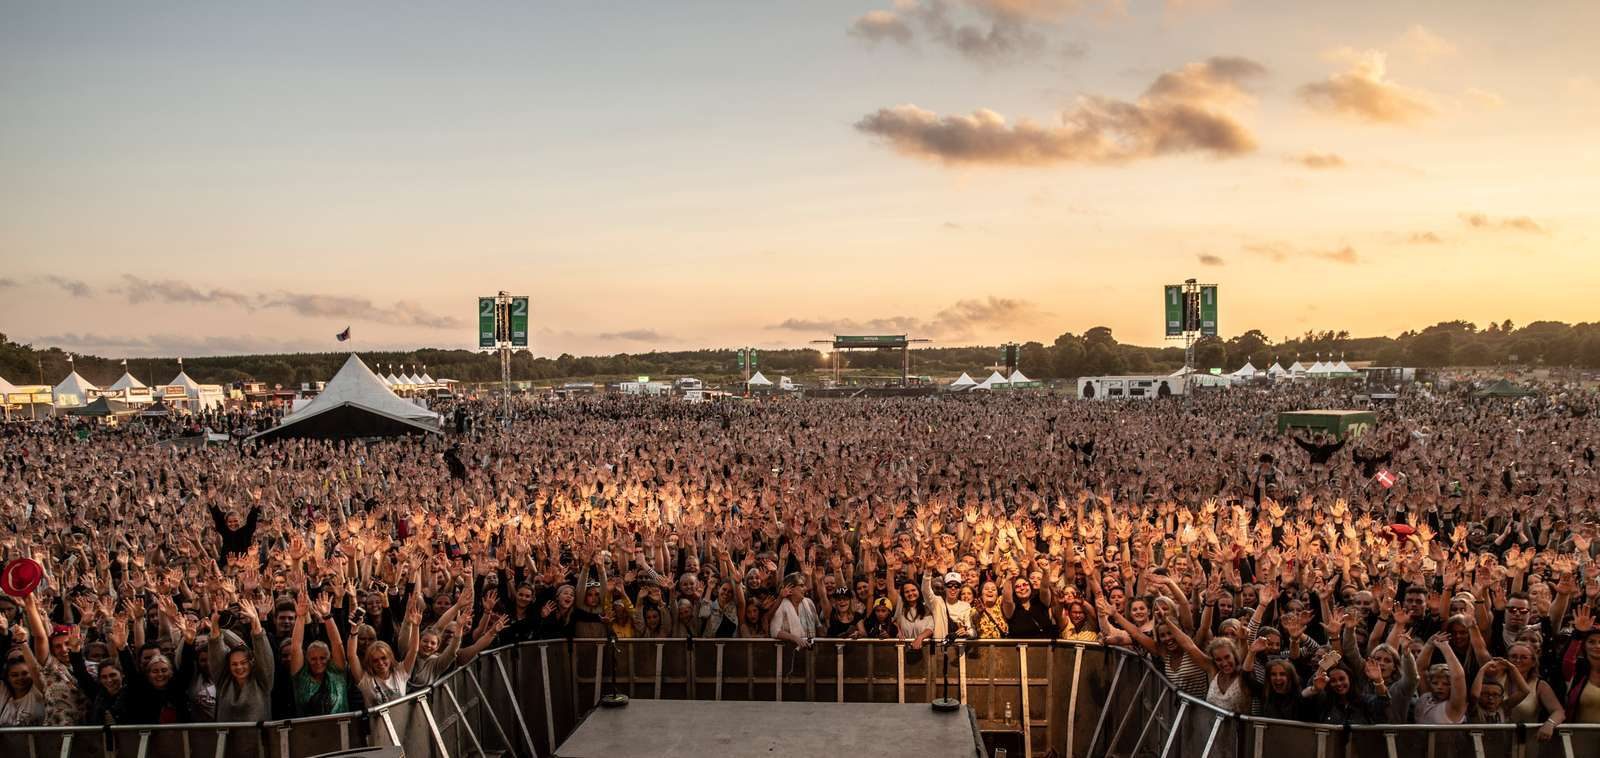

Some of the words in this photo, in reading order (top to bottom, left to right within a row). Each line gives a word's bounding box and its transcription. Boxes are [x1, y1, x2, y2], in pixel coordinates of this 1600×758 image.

[1168, 288, 1177, 304] 1
[1203, 288, 1212, 304] 1
[481, 300, 494, 317] 2
[513, 300, 526, 316] 2
